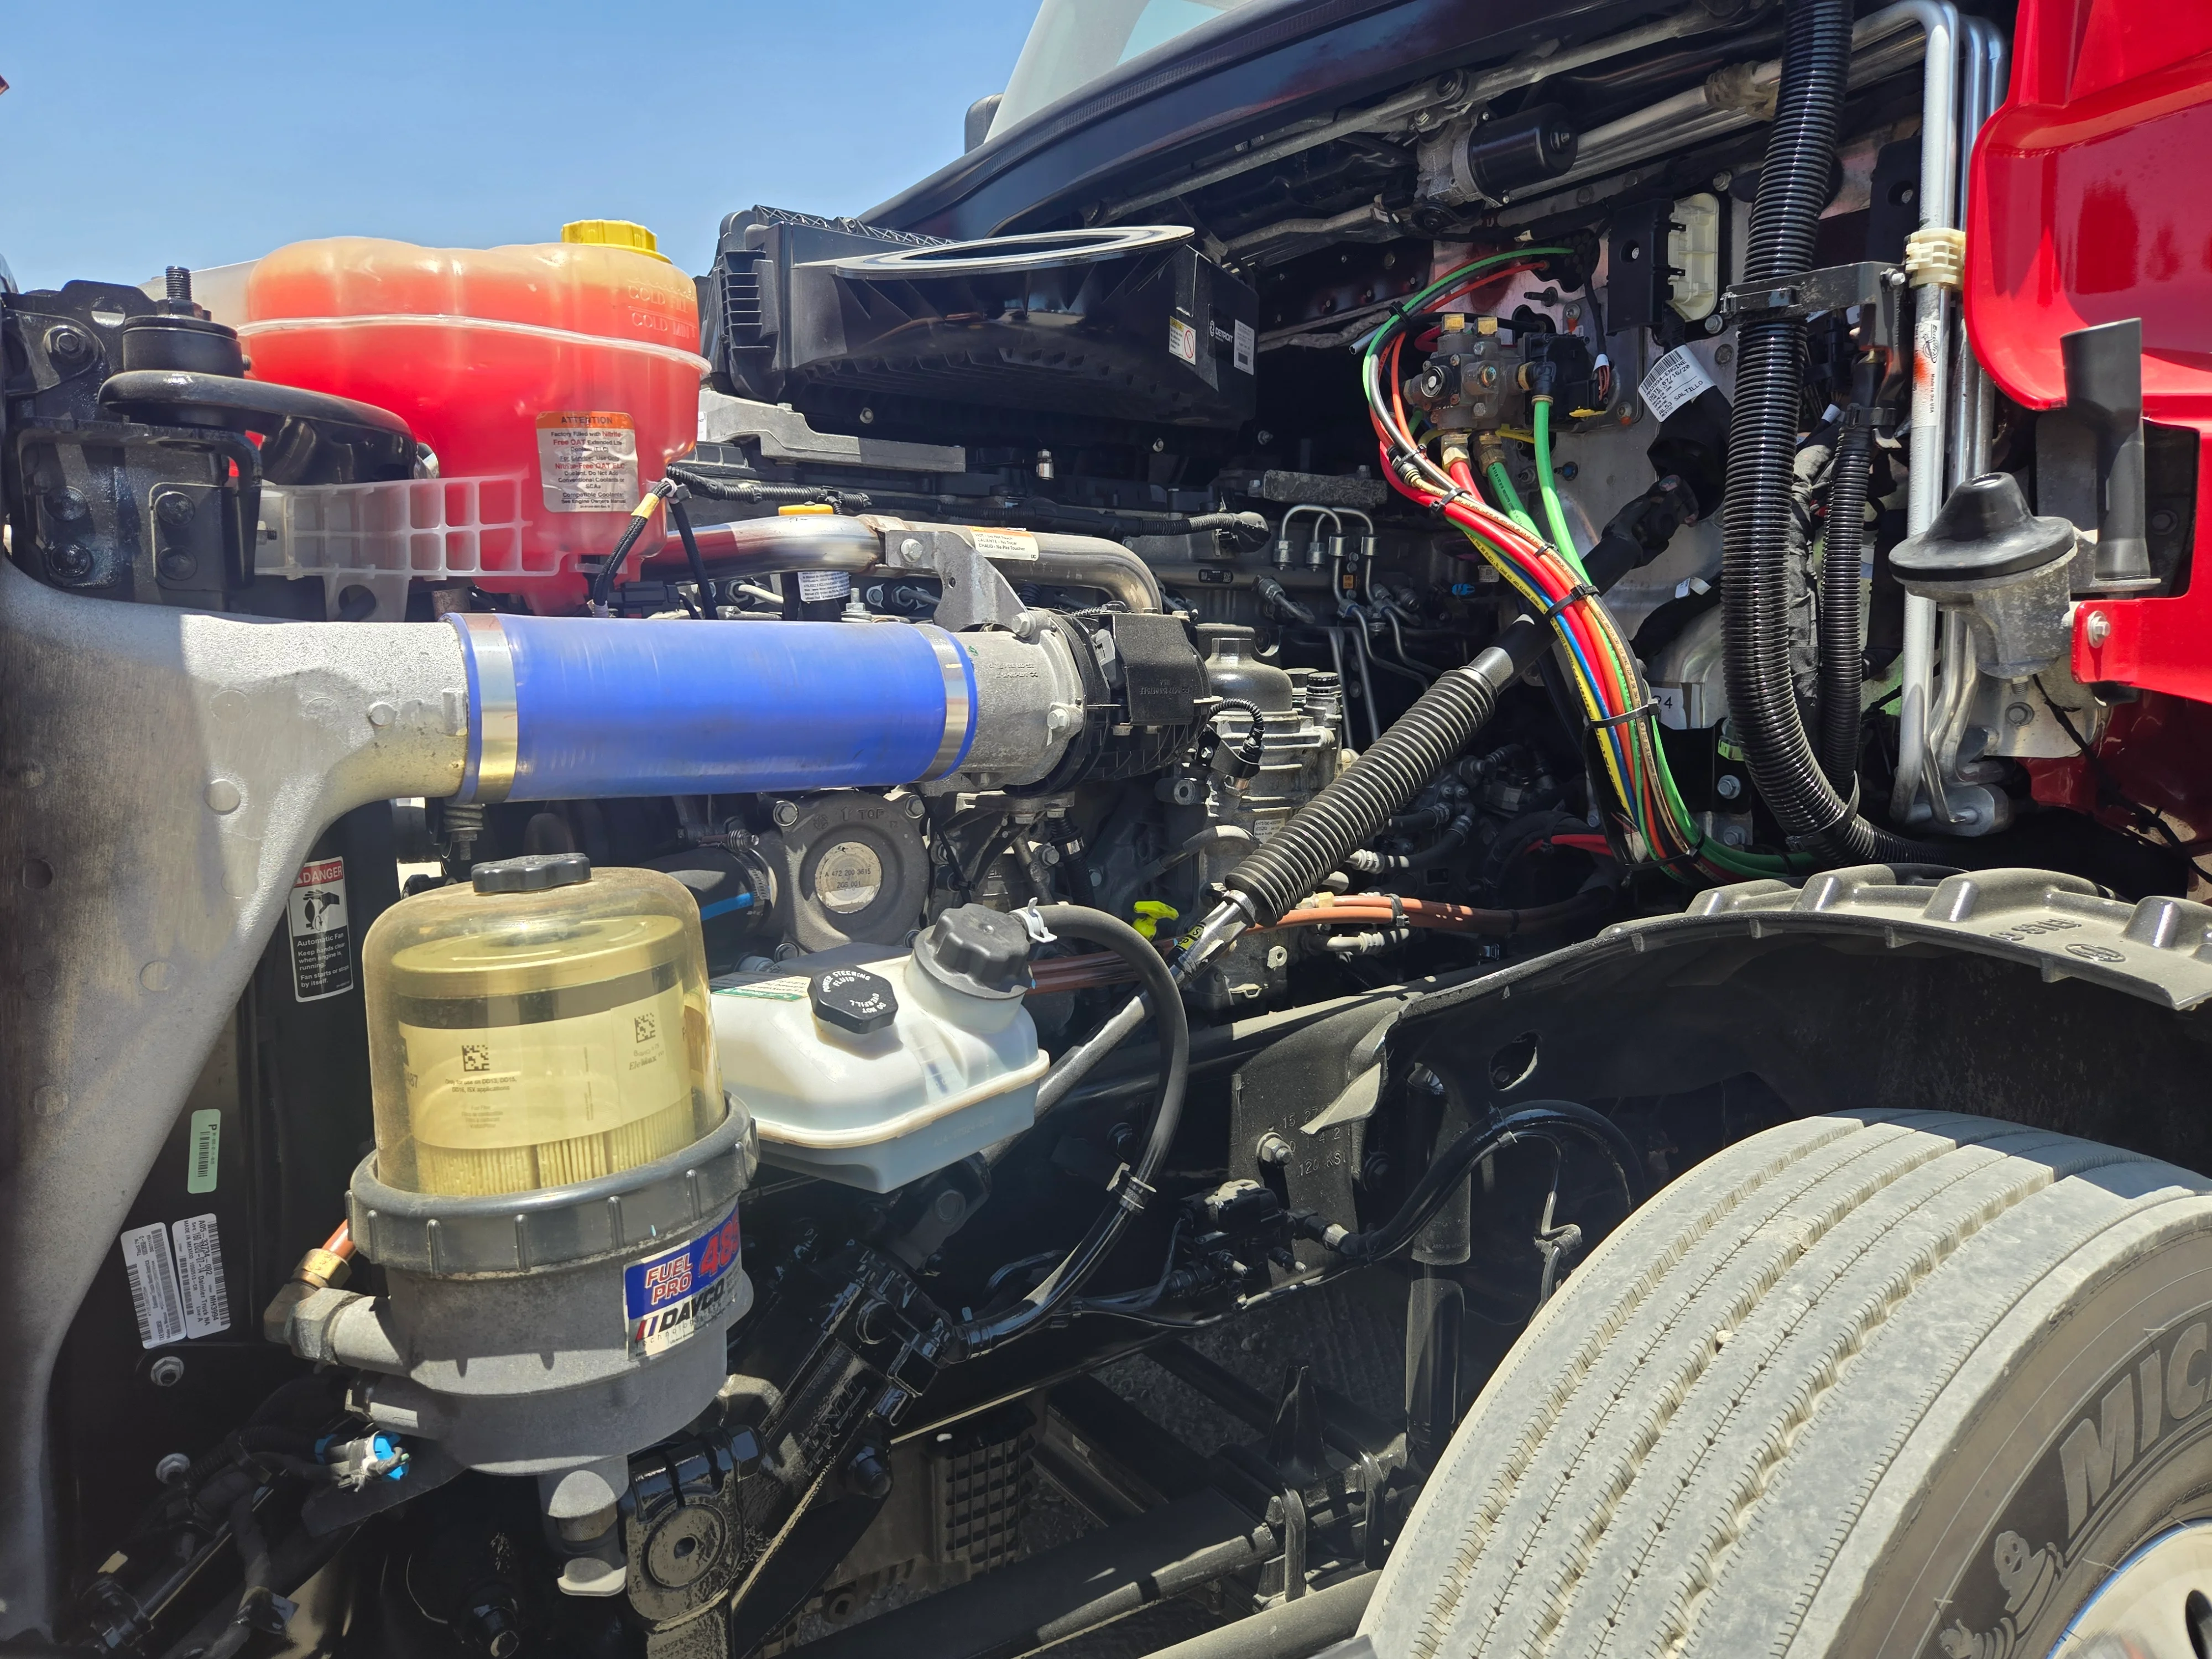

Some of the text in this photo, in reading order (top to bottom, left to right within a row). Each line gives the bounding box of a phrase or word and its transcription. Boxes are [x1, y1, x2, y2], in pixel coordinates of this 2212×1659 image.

[628, 285, 666, 305] COLD
[632, 312, 667, 332] COLD
[1215, 327, 1233, 343] DETROIT
[1674, 380, 1703, 401] SALTILLO
[561, 416, 613, 424] ATTENTION
[858, 807, 885, 820] TOP
[302, 865, 343, 884] DANGER
[297, 935, 334, 947] Automatic
[316, 945, 333, 953] hands
[317, 952, 336, 961] engine
[311, 978, 328, 986] itself.
[822, 975, 833, 993] POWER
[832, 970, 871, 981] STEERING
[833, 976, 855, 987] FLUID
[849, 993, 880, 1008] OVERFILL
[876, 1001, 887, 1010] DO
[1282, 1112, 1296, 1129] 15
[1300, 1149, 1347, 1176] 120 KSI
[644, 1252, 693, 1288] FUEL
[651, 1271, 692, 1306] PRO
[197, 1275, 206, 1298] Daimler
[204, 1317, 210, 1326] NA
[209, 1295, 219, 1321] MH3994
[658, 1277, 725, 1333] DAVCO
[2060, 1322, 2212, 1540] MIC
